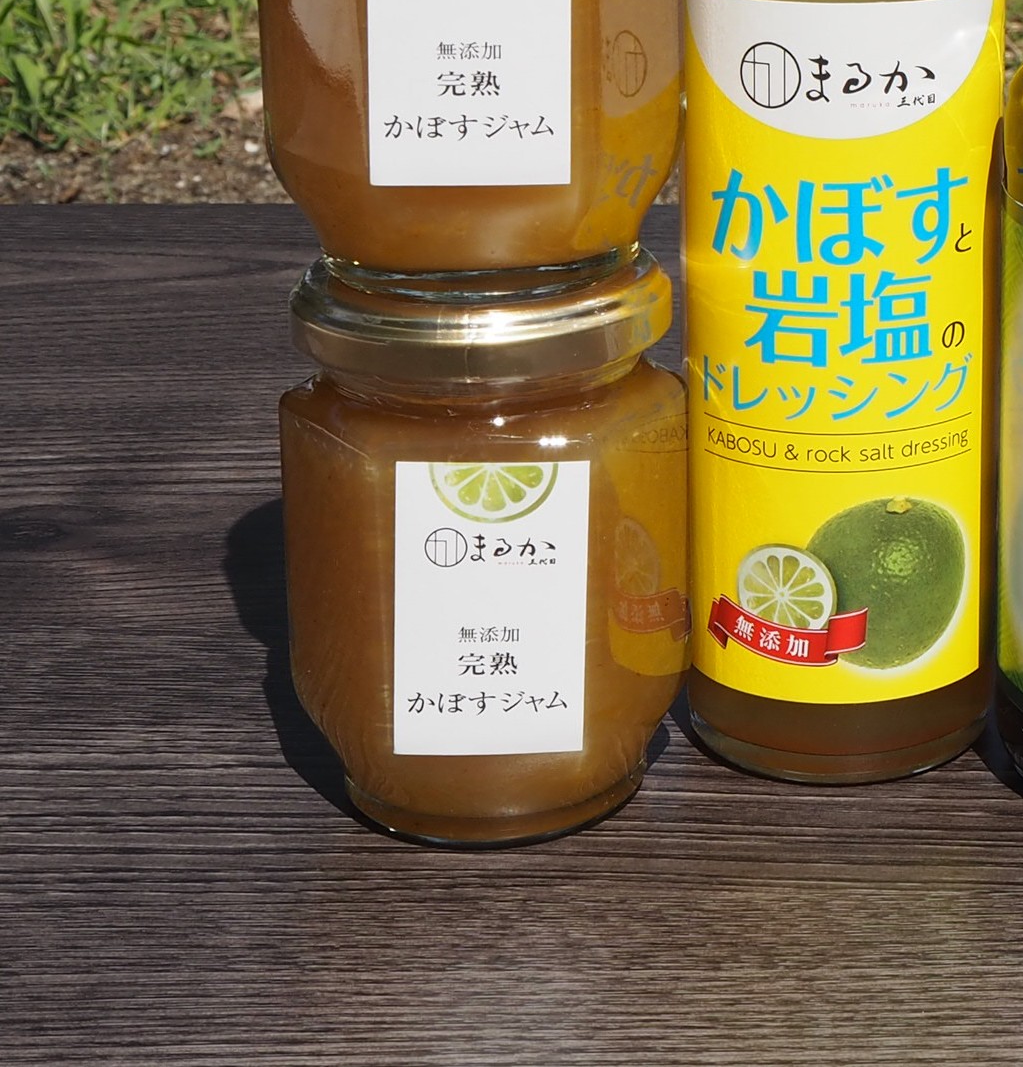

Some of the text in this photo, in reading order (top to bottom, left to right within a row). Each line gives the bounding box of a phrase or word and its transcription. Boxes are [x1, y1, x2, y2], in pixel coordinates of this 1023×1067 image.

[436, 41, 503, 60] 無添加
[436, 70, 501, 97] 完熟
[805, 54, 936, 103] まるか
[896, 93, 937, 108] 三代目
[384, 114, 555, 142] かぼすジャム
[711, 167, 973, 266] かぼすと
[744, 270, 966, 368] 岩塩の
[703, 352, 973, 422] ドレッシング
[707, 426, 970, 463] KABOSU & rock salt dressing
[469, 533, 557, 562] まるか
[457, 625, 521, 644] 無添加
[733, 613, 810, 658] 無添加
[457, 651, 519, 677] 完熟
[407, 691, 569, 716] かぼすジャム
